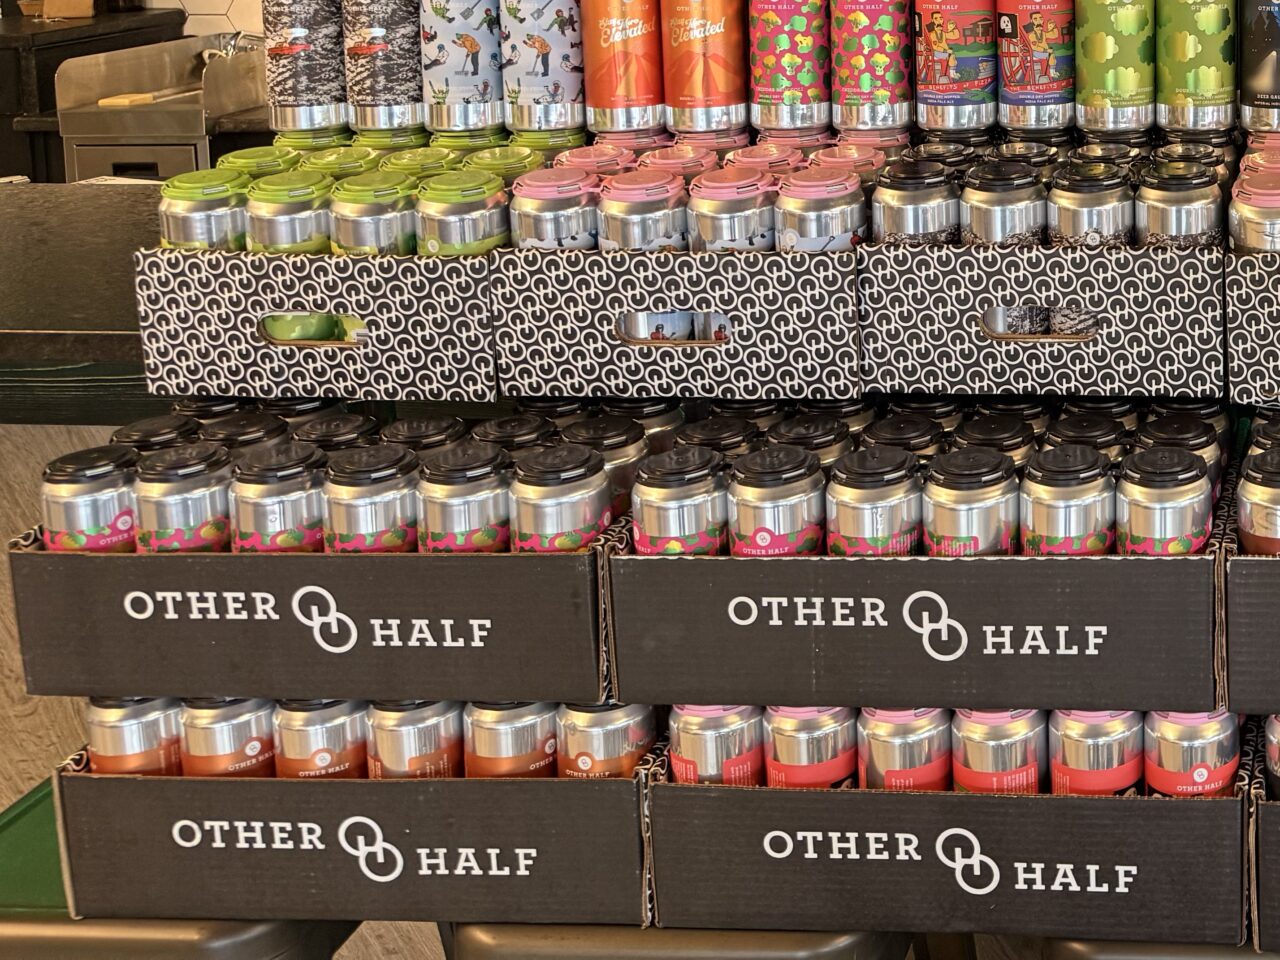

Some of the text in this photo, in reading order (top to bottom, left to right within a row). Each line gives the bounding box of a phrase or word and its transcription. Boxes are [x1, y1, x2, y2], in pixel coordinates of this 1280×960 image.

[601, 16, 656, 48] Elevated
[672, 17, 725, 47] Elevated
[99, 534, 128, 545] OTHER
[742, 546, 788, 555] OTHER HALF
[123, 590, 493, 648] OTHER HALF
[728, 595, 1108, 655] OTHER HALF
[228, 758, 256, 771] OTHER
[298, 763, 350, 777] OTHER HALF
[566, 769, 586, 778] OTHER
[1204, 782, 1223, 790] HALF
[170, 819, 538, 876] OTHER HALF
[763, 830, 1138, 893] OTHER HALF
